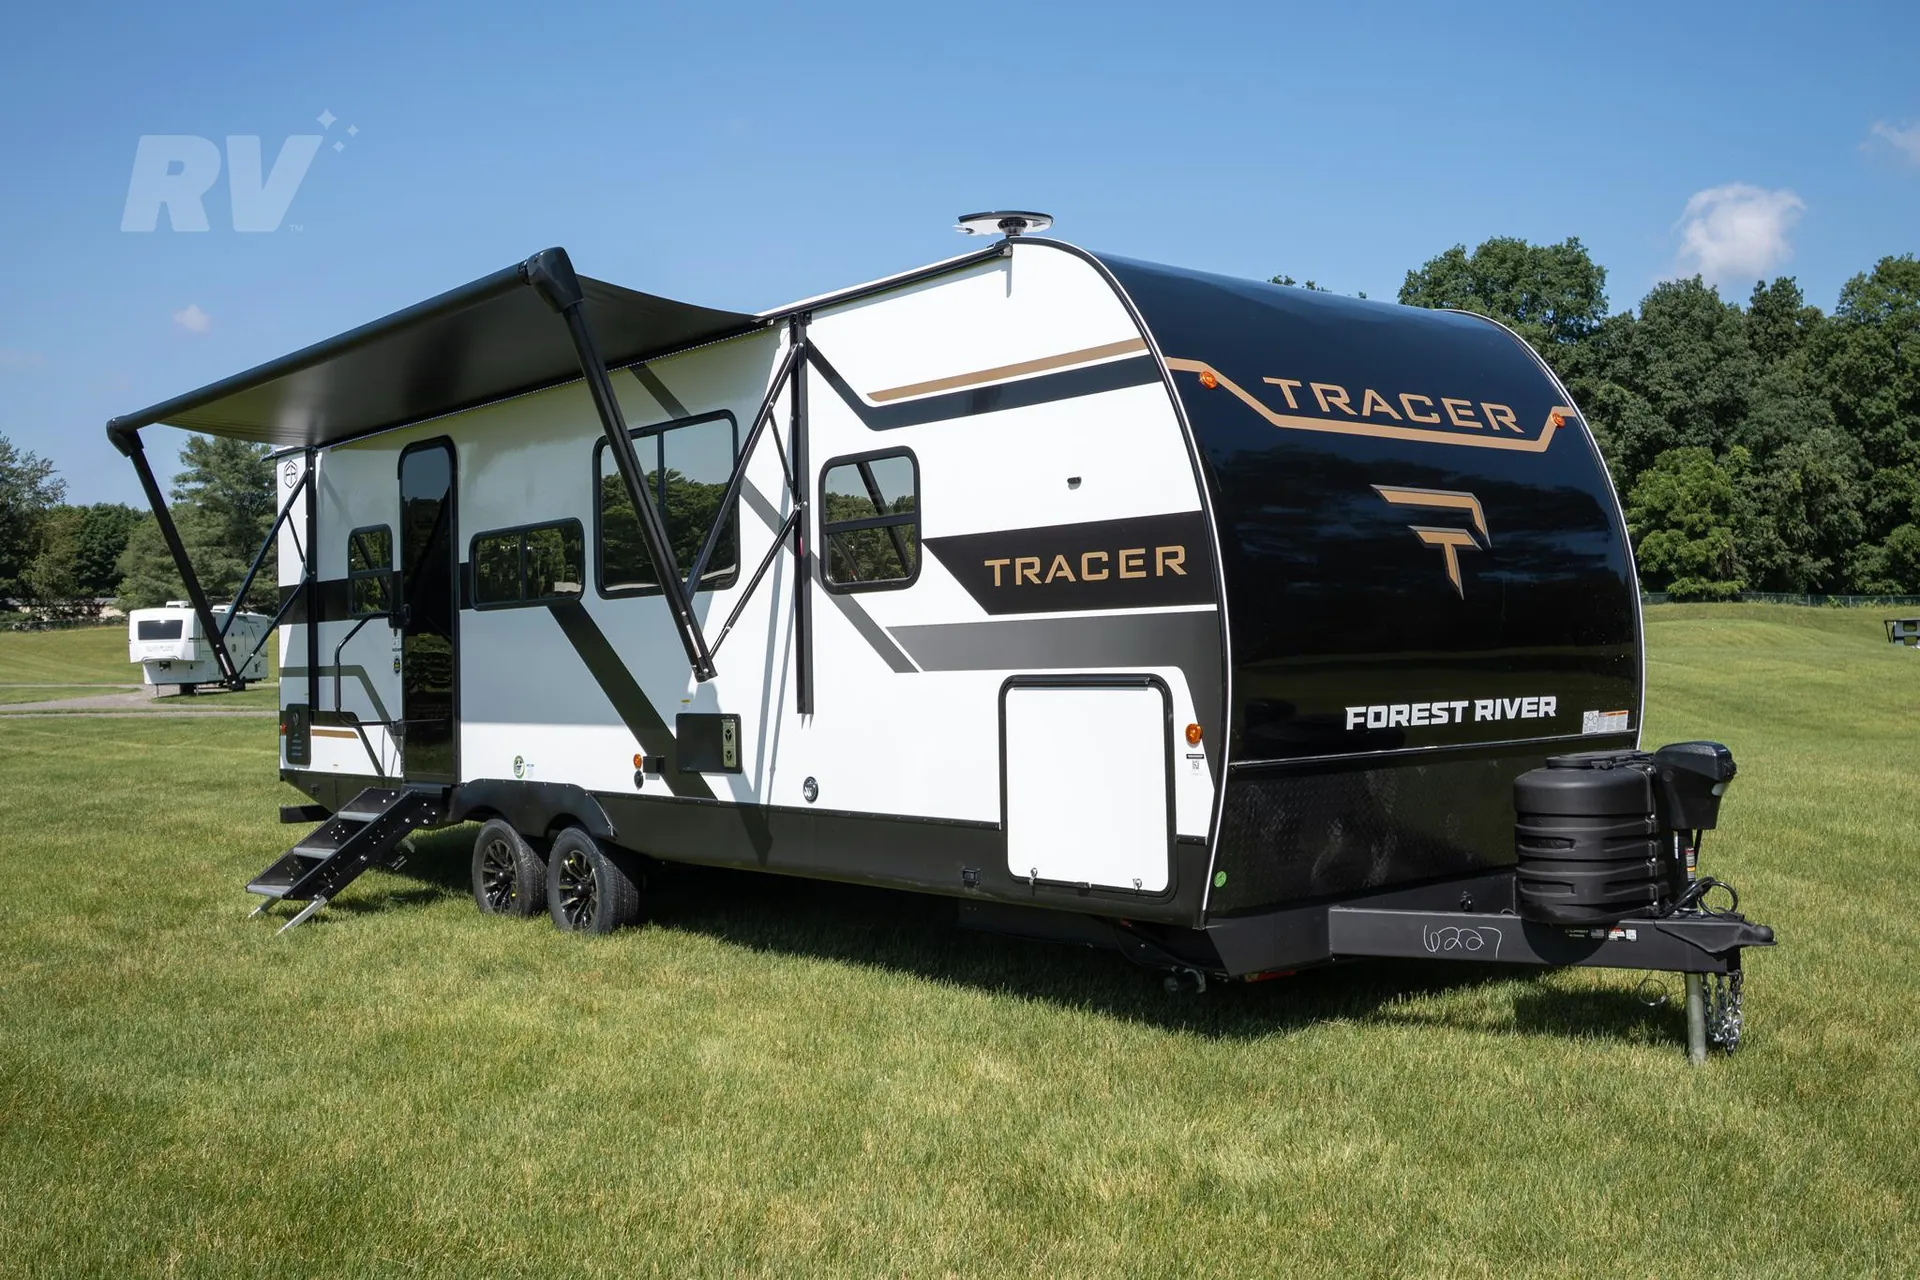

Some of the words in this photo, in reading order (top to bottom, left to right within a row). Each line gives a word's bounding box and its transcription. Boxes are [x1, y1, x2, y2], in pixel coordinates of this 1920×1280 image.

[1262, 376, 1525, 434] TRACER
[984, 545, 1188, 587] TRACER
[1345, 700, 1469, 731] FOREST
[1473, 696, 1557, 722] RIVER
